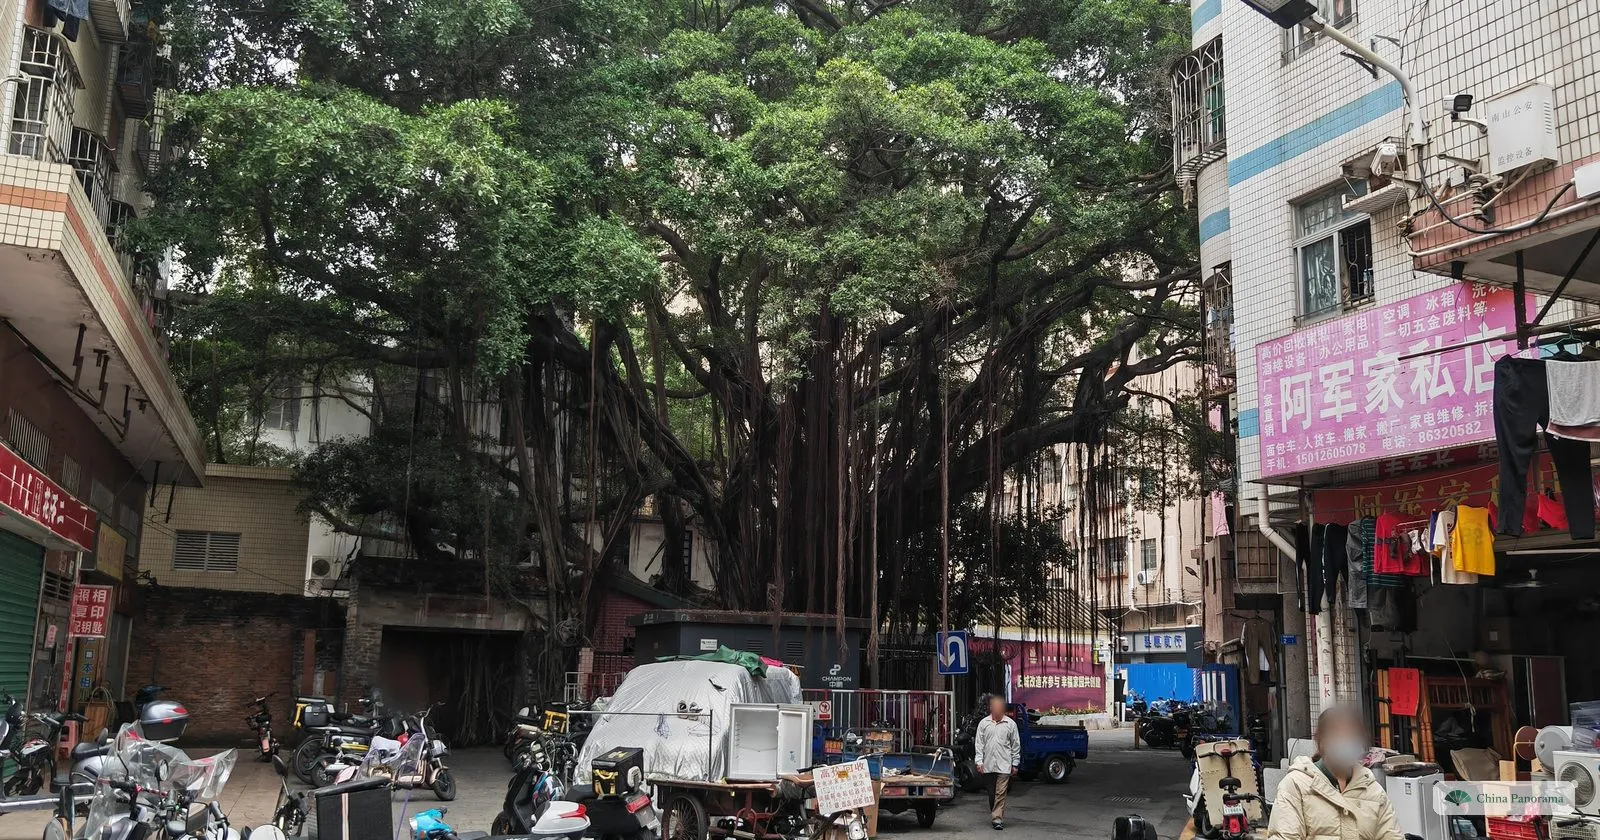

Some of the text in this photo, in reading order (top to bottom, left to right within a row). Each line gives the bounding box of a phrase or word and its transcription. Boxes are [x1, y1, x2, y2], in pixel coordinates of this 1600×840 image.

[1492, 102, 1532, 123] 南山公安
[1498, 147, 1532, 166] 监控设备
[1280, 321, 1506, 434] 阿军家私店
[1263, 379, 1274, 437] 厂家直销
